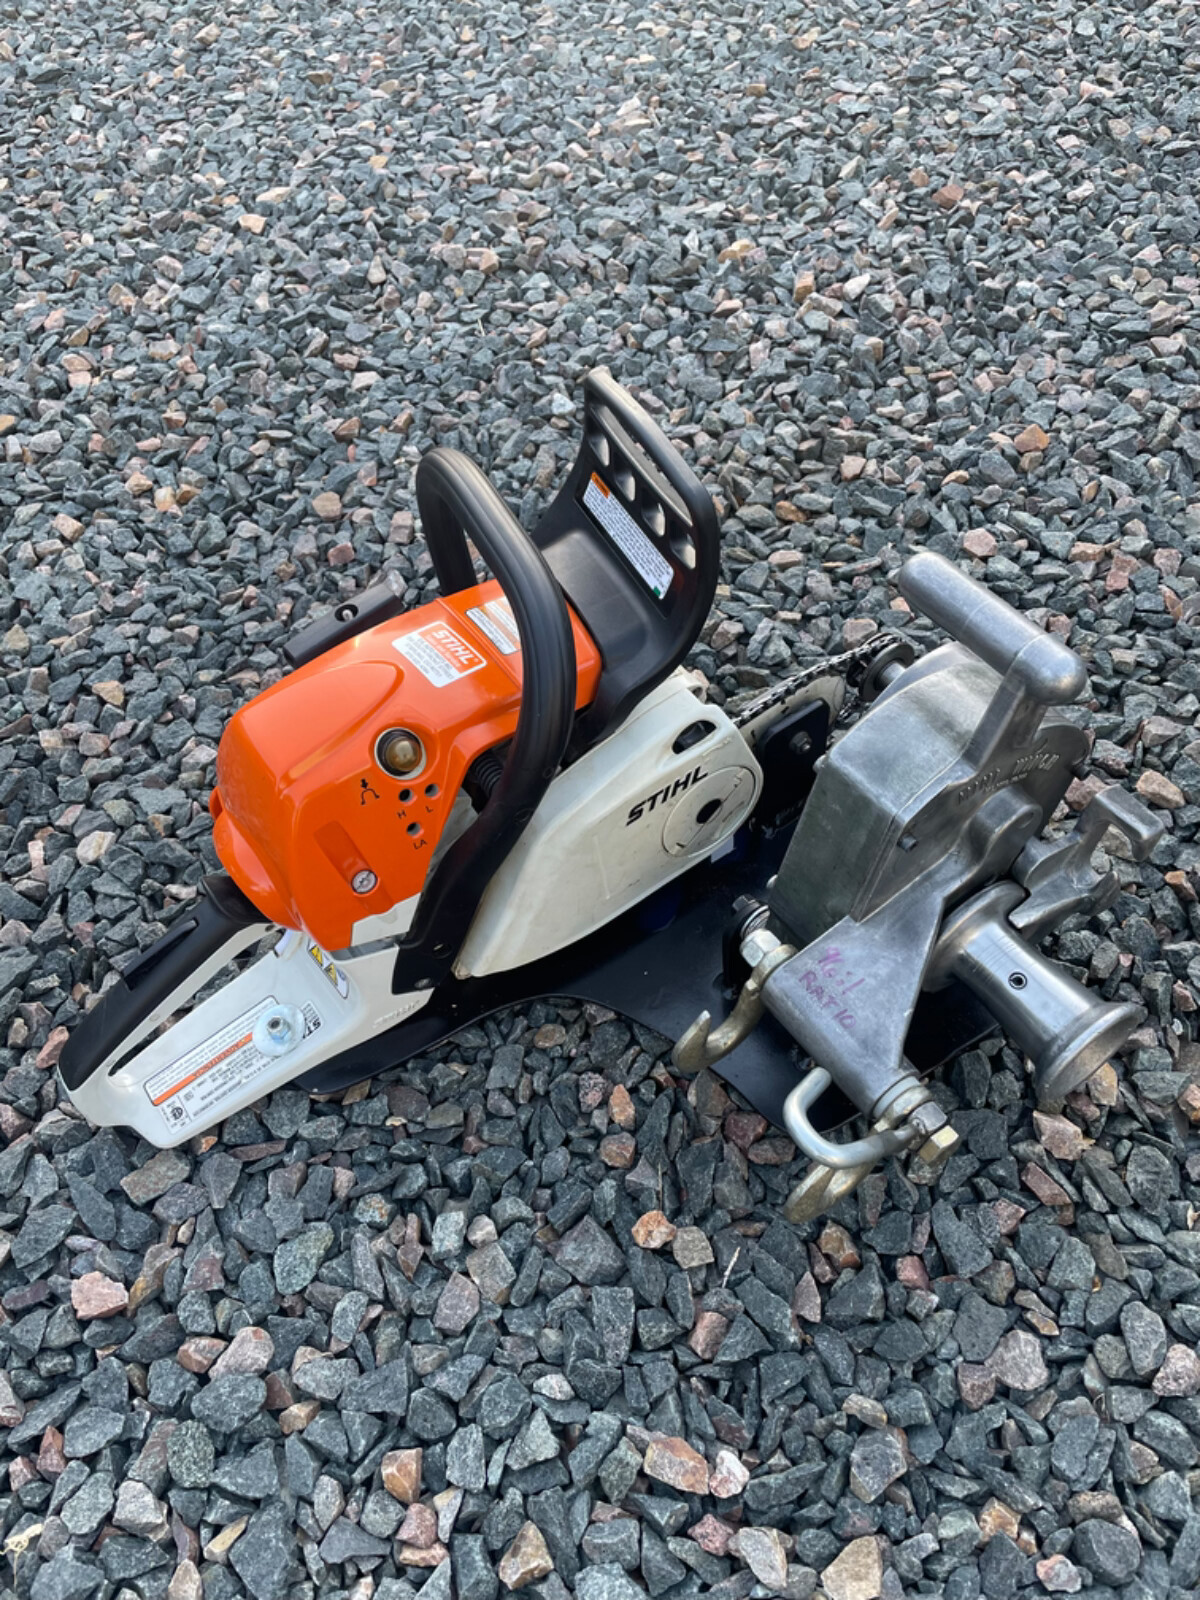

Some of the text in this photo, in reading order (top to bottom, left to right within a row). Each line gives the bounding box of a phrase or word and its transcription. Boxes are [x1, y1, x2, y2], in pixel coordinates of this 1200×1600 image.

[431, 629, 474, 665] STIHL
[625, 766, 708, 827] STIHL
[413, 839, 427, 850] LA
[798, 970, 857, 1029] RATIO
